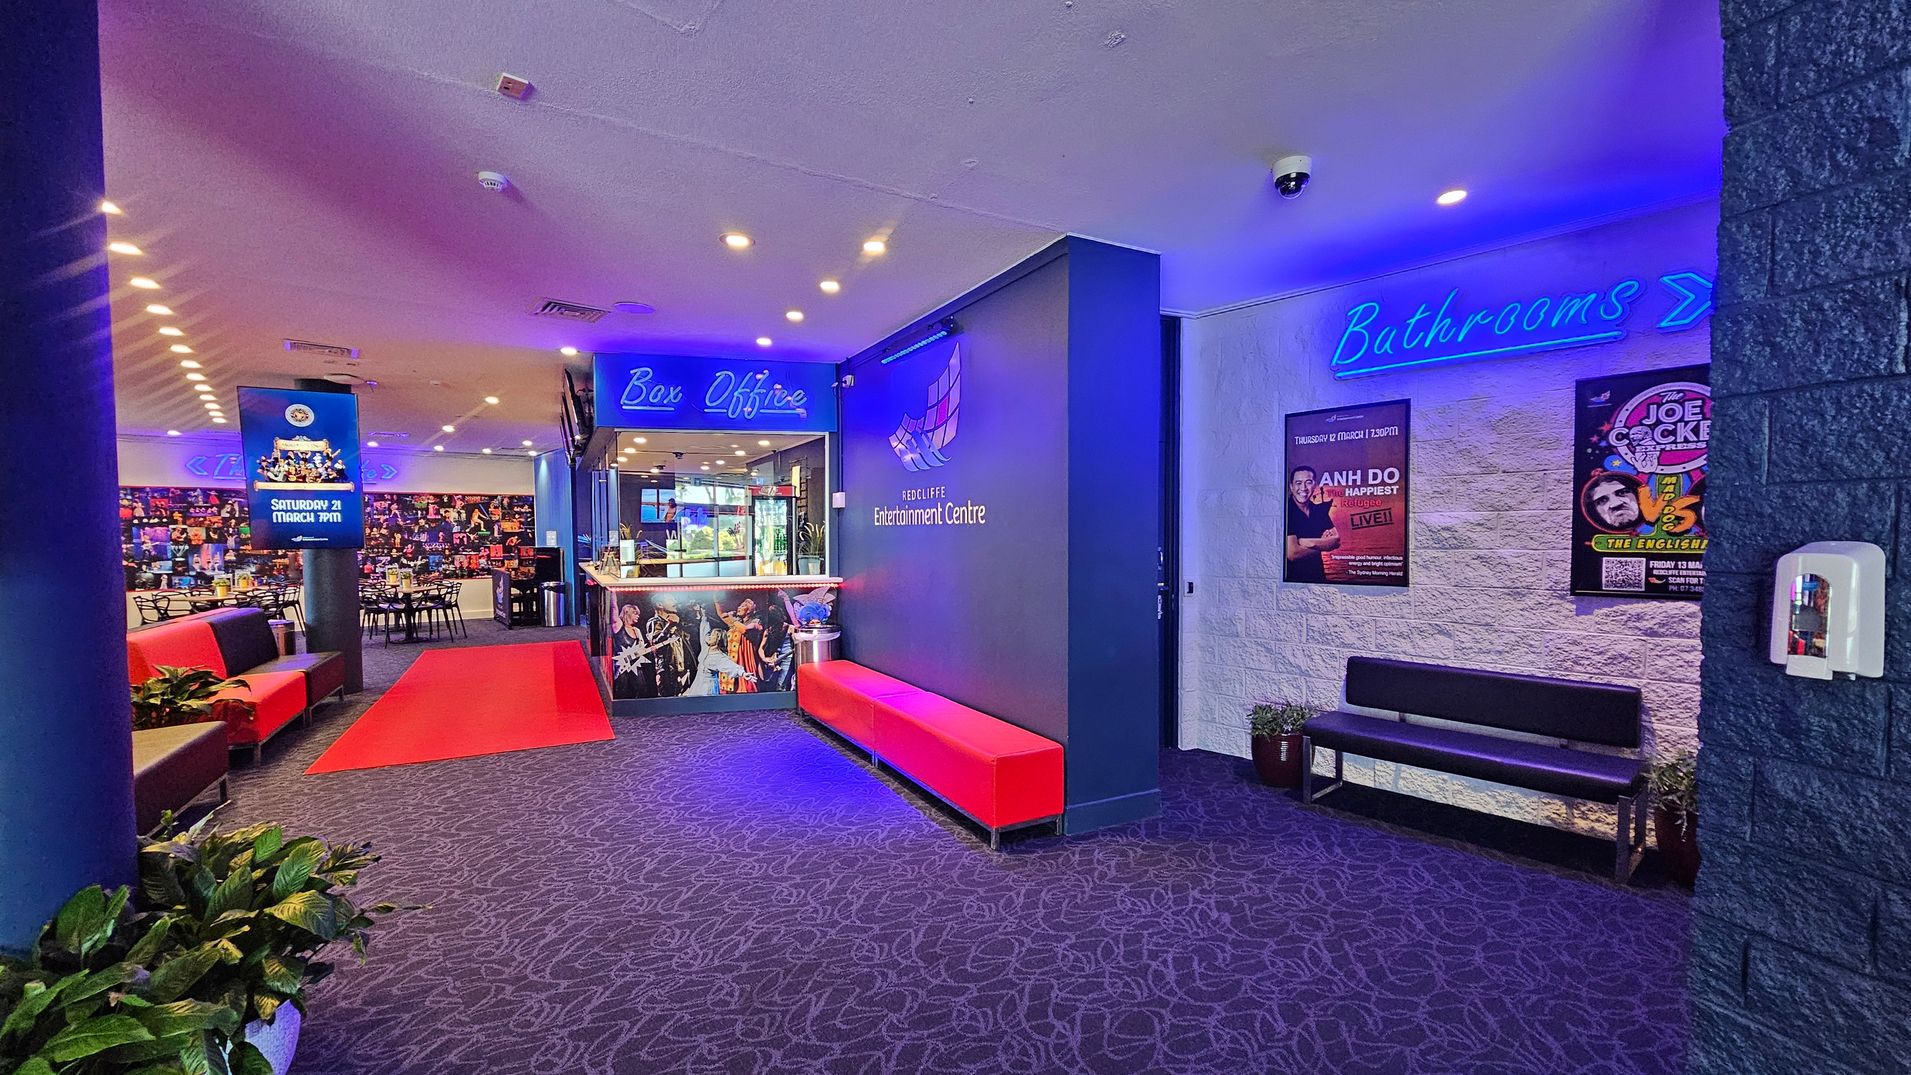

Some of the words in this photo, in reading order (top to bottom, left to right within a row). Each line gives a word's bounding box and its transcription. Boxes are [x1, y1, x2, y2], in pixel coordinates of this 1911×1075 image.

[1331, 279, 1641, 365] Bathrooms
[620, 366, 683, 406] Box
[704, 369, 808, 420] Office
[1658, 391, 1685, 403] The
[1641, 399, 1703, 425] JOE
[1294, 433, 1329, 446] THURSDAY
[1329, 432, 1337, 443] 12
[1337, 430, 1364, 442] MARCH
[1608, 420, 1711, 447] COCKE
[1635, 441, 1708, 452] EXPRESS
[1319, 469, 1362, 487] ANH
[1368, 467, 1400, 485] DO
[902, 486, 946, 501] REDCLIFFE
[1345, 485, 1400, 497] HAPPIEST
[270, 498, 329, 511] SATURDAY
[331, 500, 342, 511] 21
[1341, 499, 1383, 510] Refugee
[272, 511, 315, 523] MARCH
[317, 512, 342, 523] 7PM
[874, 502, 943, 526] Entertainment
[945, 500, 986, 525] Centre
[1606, 539, 1632, 550] THE
[1649, 561, 1675, 569] FRIDAY
[1677, 561, 1687, 569] 13
[1687, 561, 1703, 569] MA
[1668, 576, 1685, 584] SCAN
[1685, 577, 1698, 585] FOR
